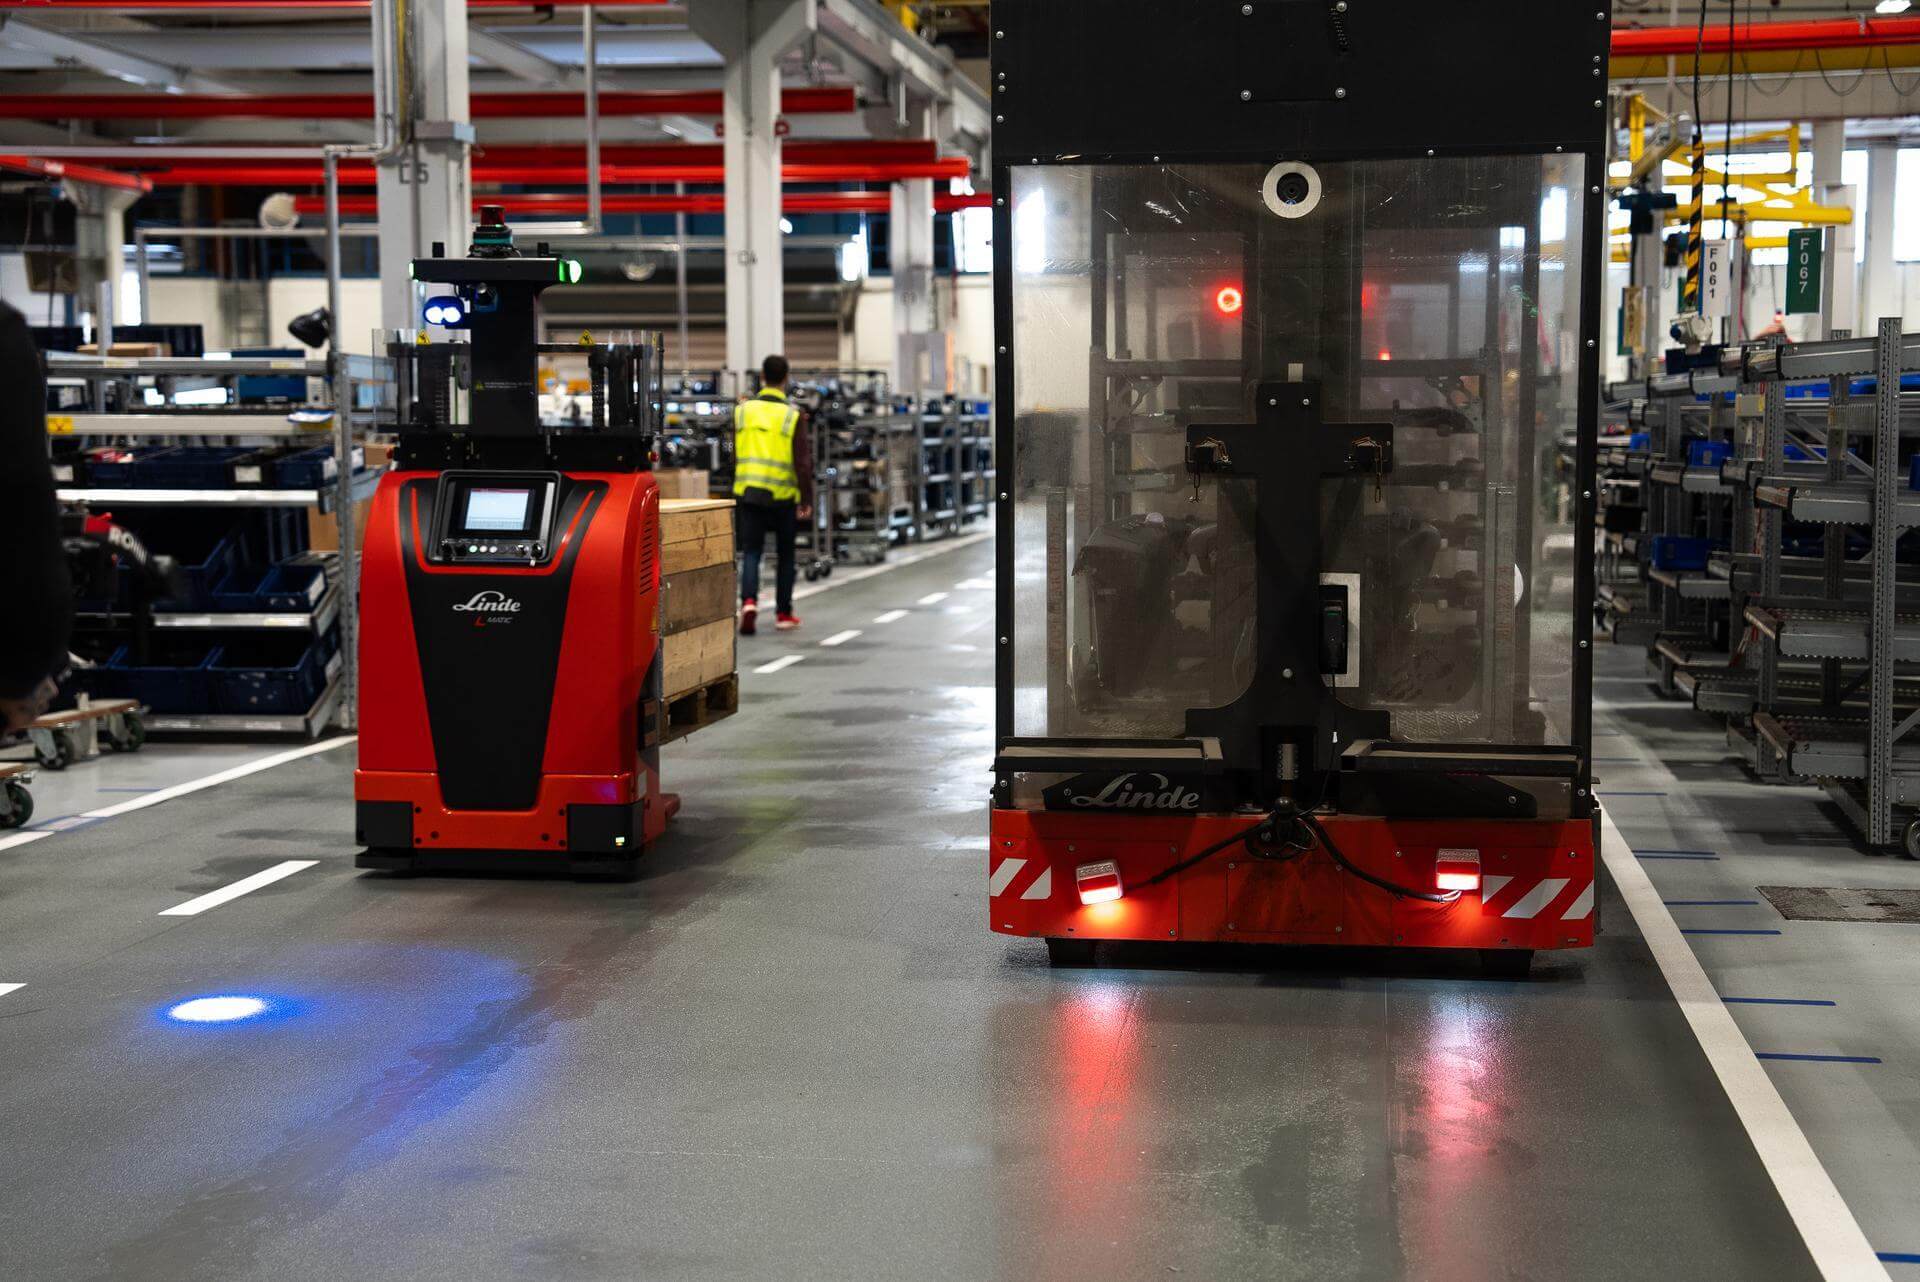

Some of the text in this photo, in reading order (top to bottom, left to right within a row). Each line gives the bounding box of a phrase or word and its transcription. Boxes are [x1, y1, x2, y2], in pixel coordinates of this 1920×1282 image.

[1709, 247, 1718, 299] F061
[1798, 238, 1810, 294] F067
[452, 590, 521, 612] Linde
[1071, 773, 1199, 809] Linde
